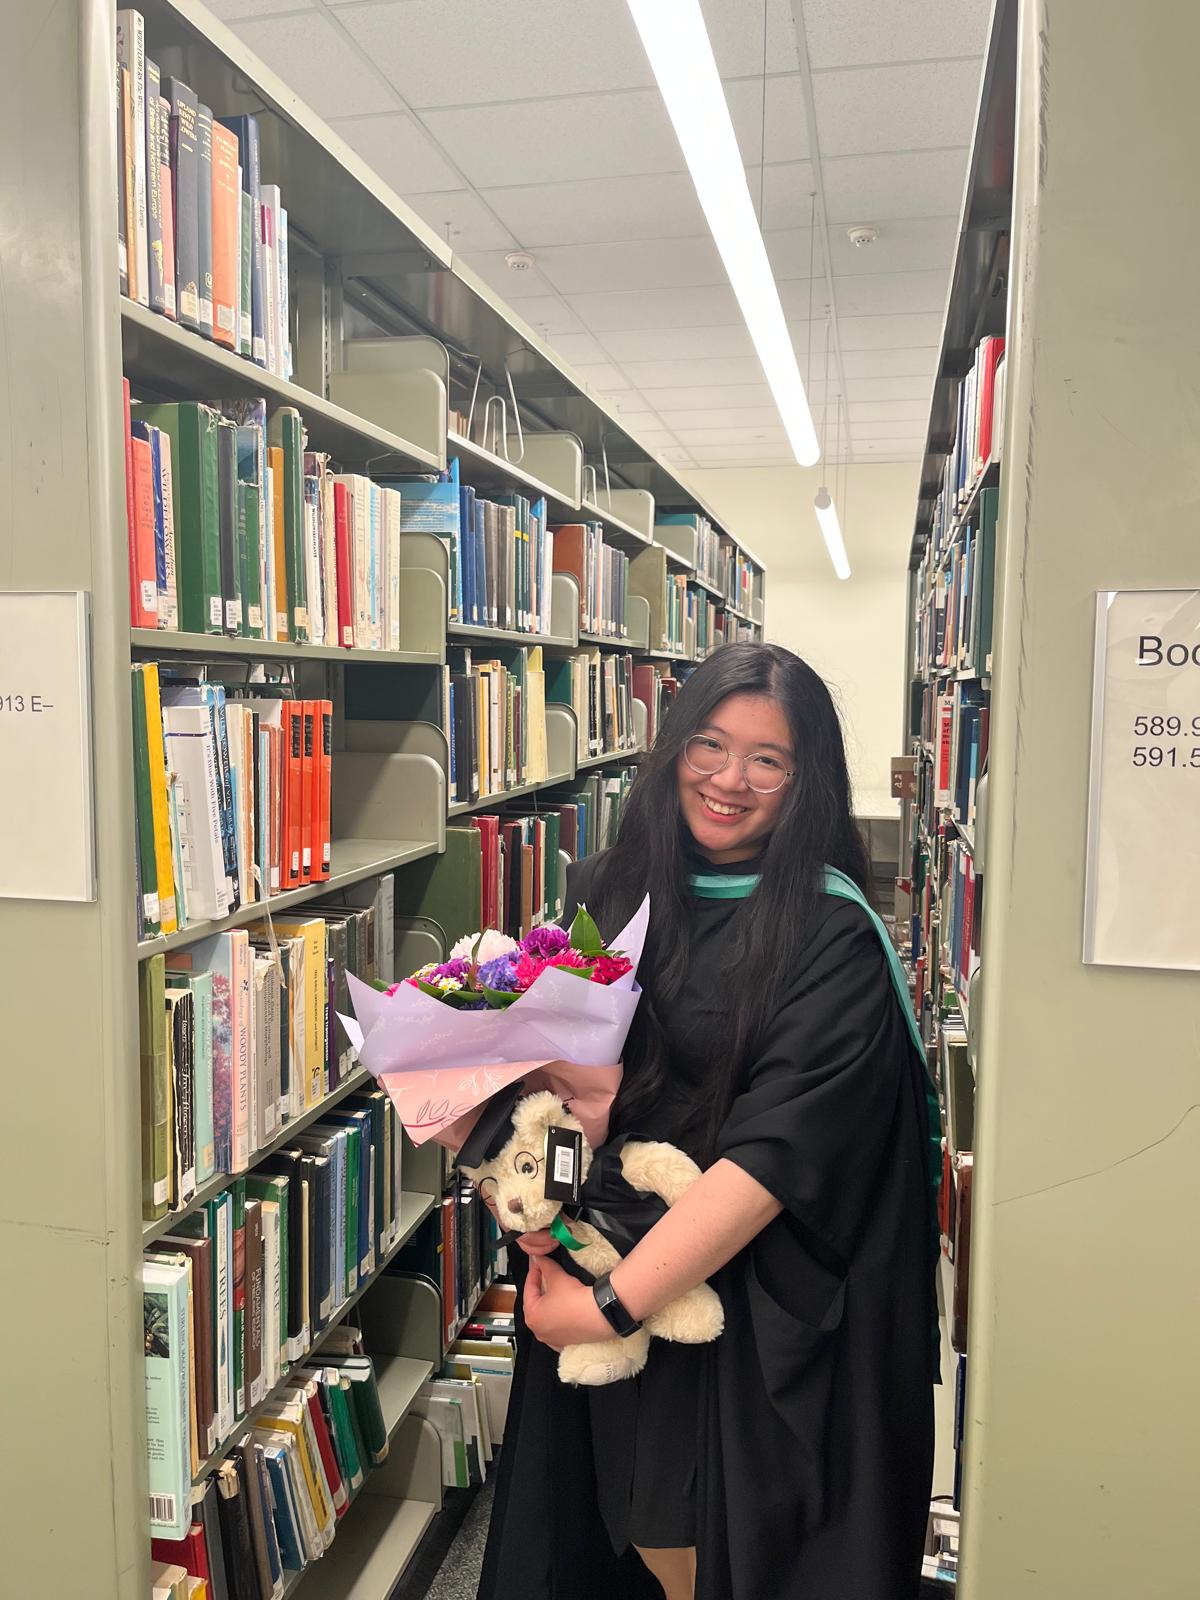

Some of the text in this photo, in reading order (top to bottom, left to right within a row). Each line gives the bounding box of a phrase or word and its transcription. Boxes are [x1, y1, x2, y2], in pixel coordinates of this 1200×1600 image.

[1132, 746, 1200, 771] 591.5
[212, 819, 220, 843] Petals
[239, 1027, 247, 1069] WOODY
[239, 1070, 247, 1112] PLANTS
